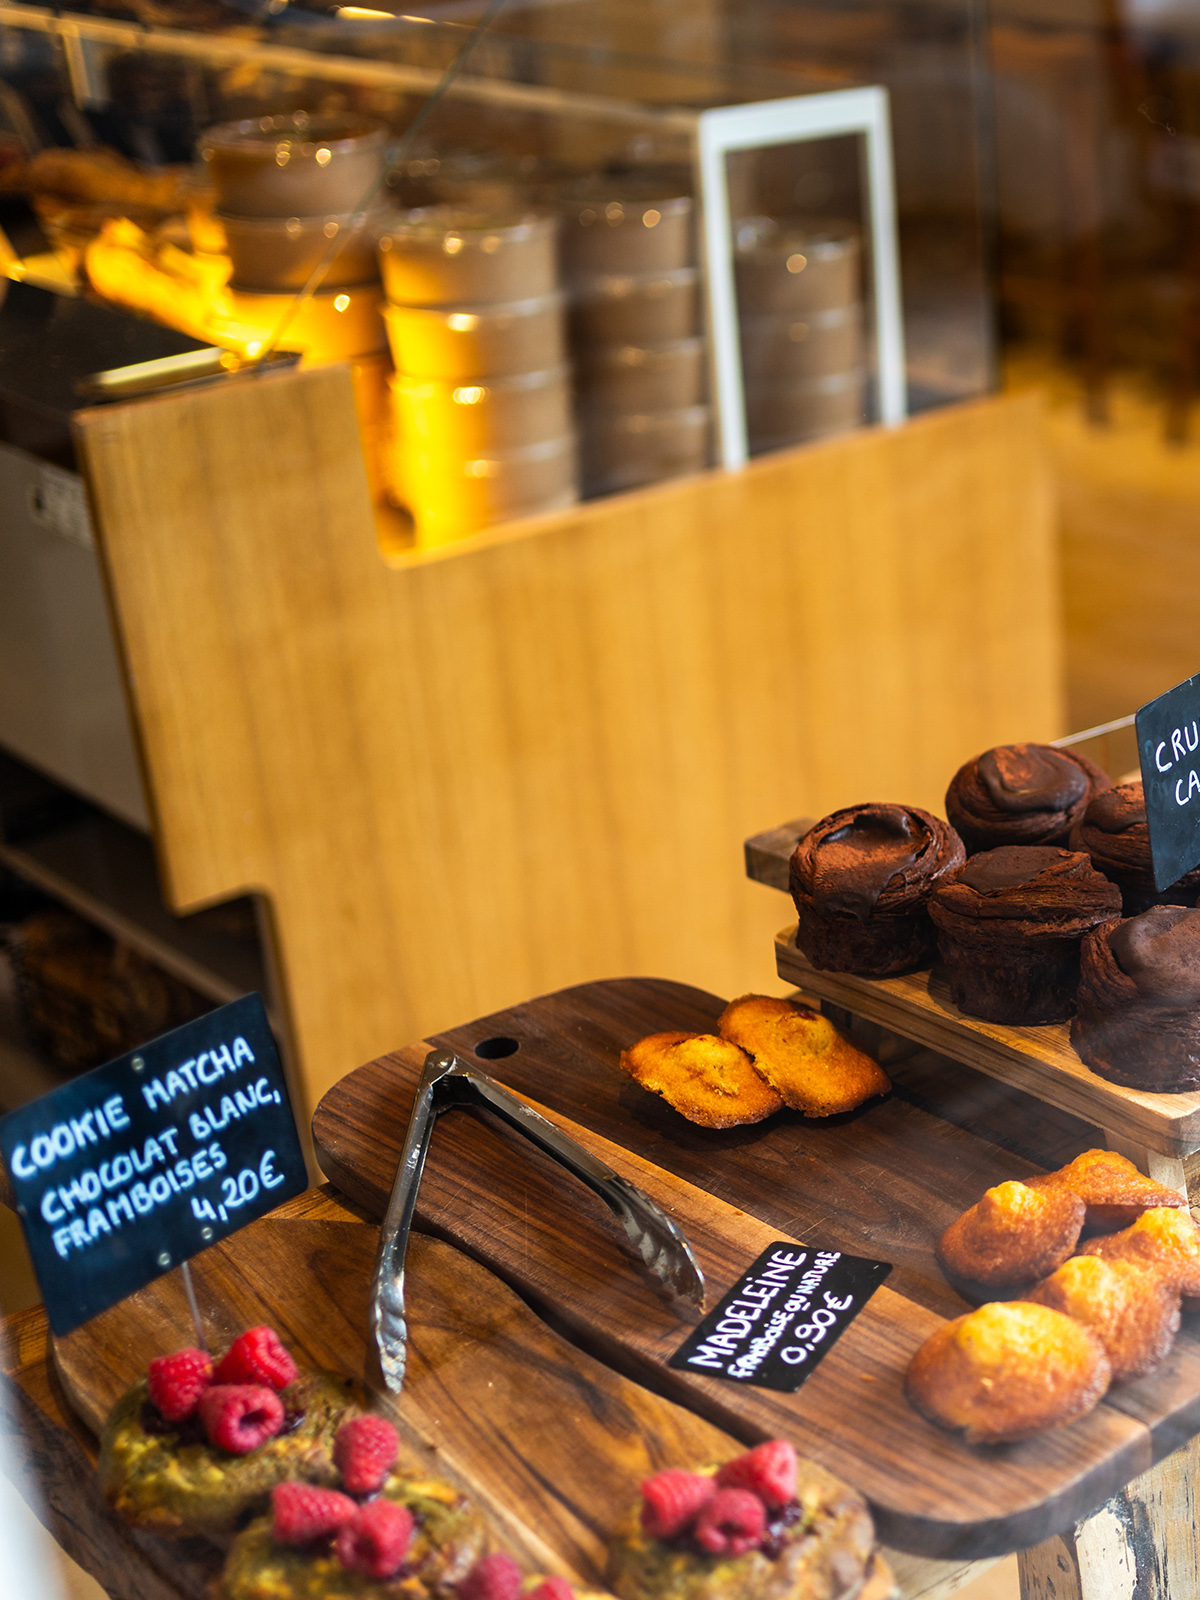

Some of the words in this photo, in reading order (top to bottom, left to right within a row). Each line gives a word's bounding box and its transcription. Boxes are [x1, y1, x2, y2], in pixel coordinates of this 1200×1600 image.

[11, 1095, 131, 1179] COOKIE
[142, 1036, 255, 1111] MATCHA
[41, 1127, 178, 1223] CHOCOLAT
[189, 1077, 281, 1140] BLANC,
[52, 1142, 227, 1259] FRAMBOISES
[190, 1150, 284, 1222] 4,20€
[796, 1251, 841, 1294] NATURE
[780, 1290, 853, 1364] 0,90€
